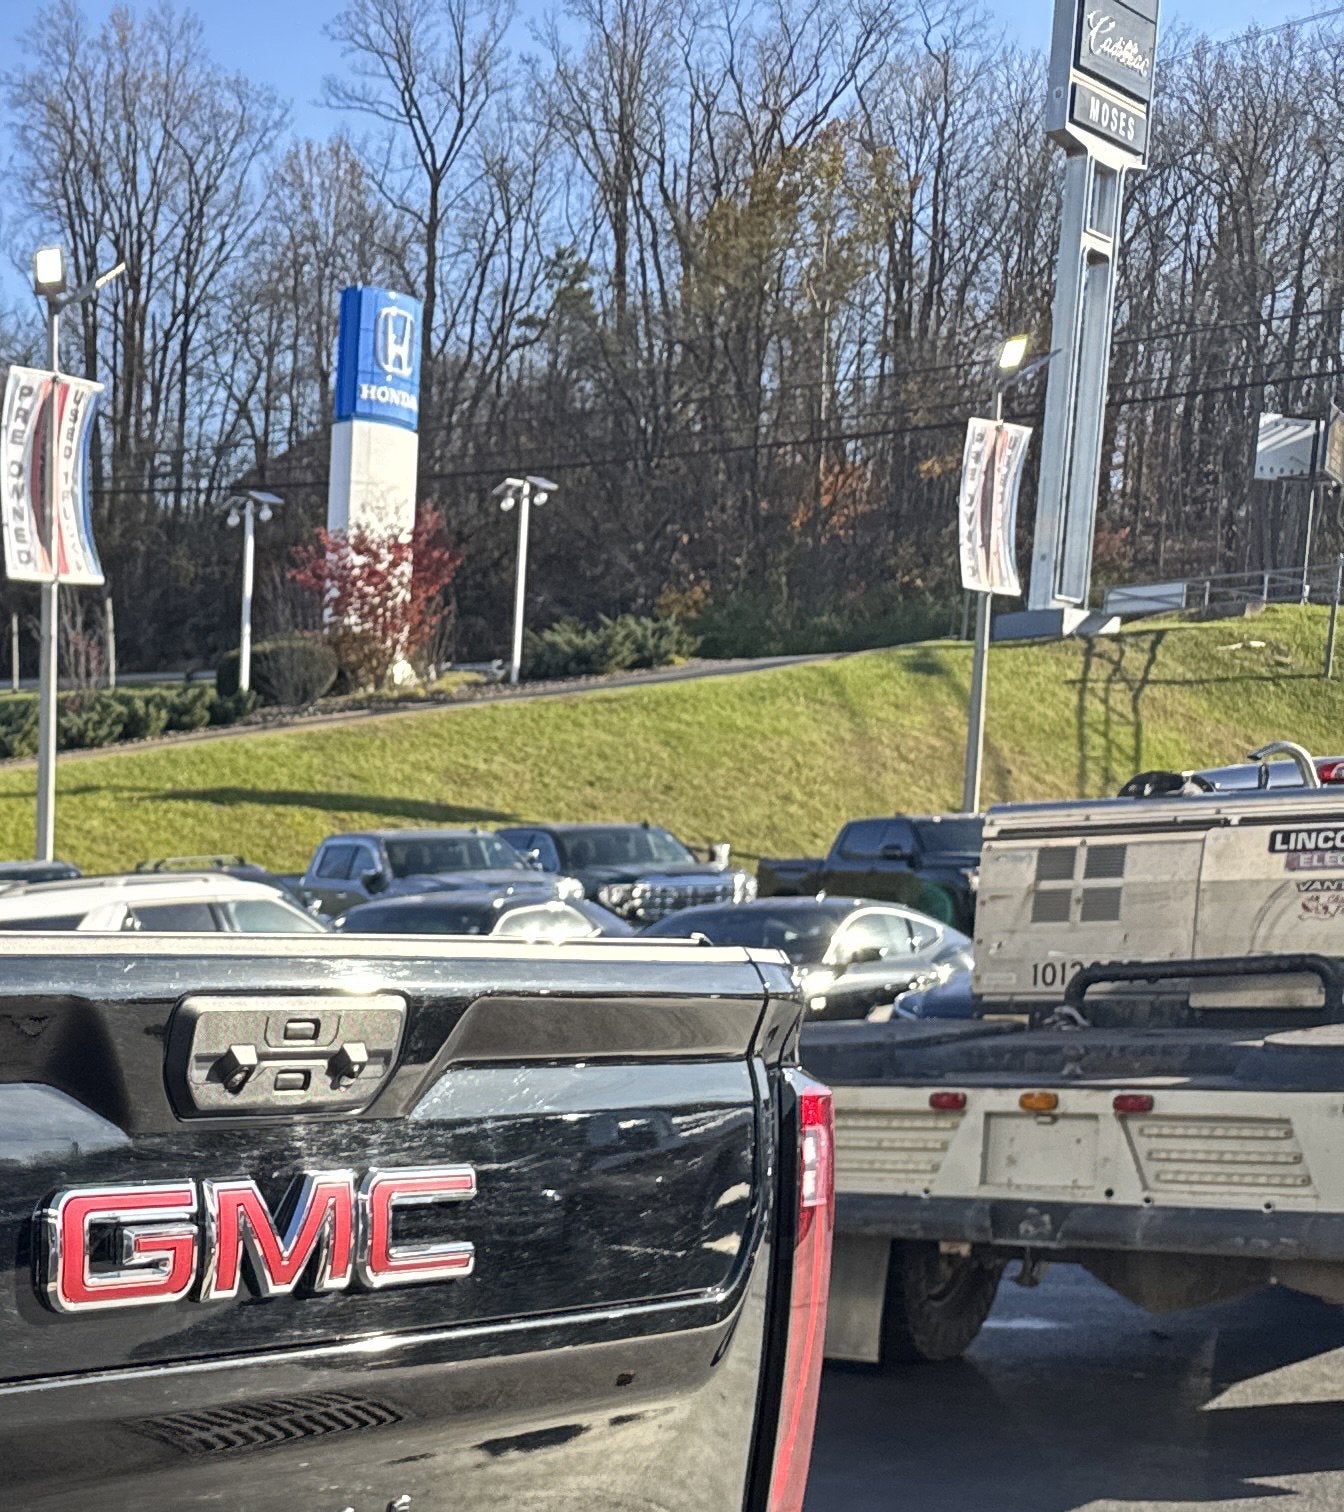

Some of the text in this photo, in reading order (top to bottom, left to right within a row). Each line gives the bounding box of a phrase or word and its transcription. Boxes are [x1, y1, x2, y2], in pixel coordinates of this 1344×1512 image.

[1089, 96, 1135, 141] MOSES
[10, 384, 34, 446] PRE
[360, 384, 418, 411] HONDA
[33, 1164, 477, 1315] GMC
